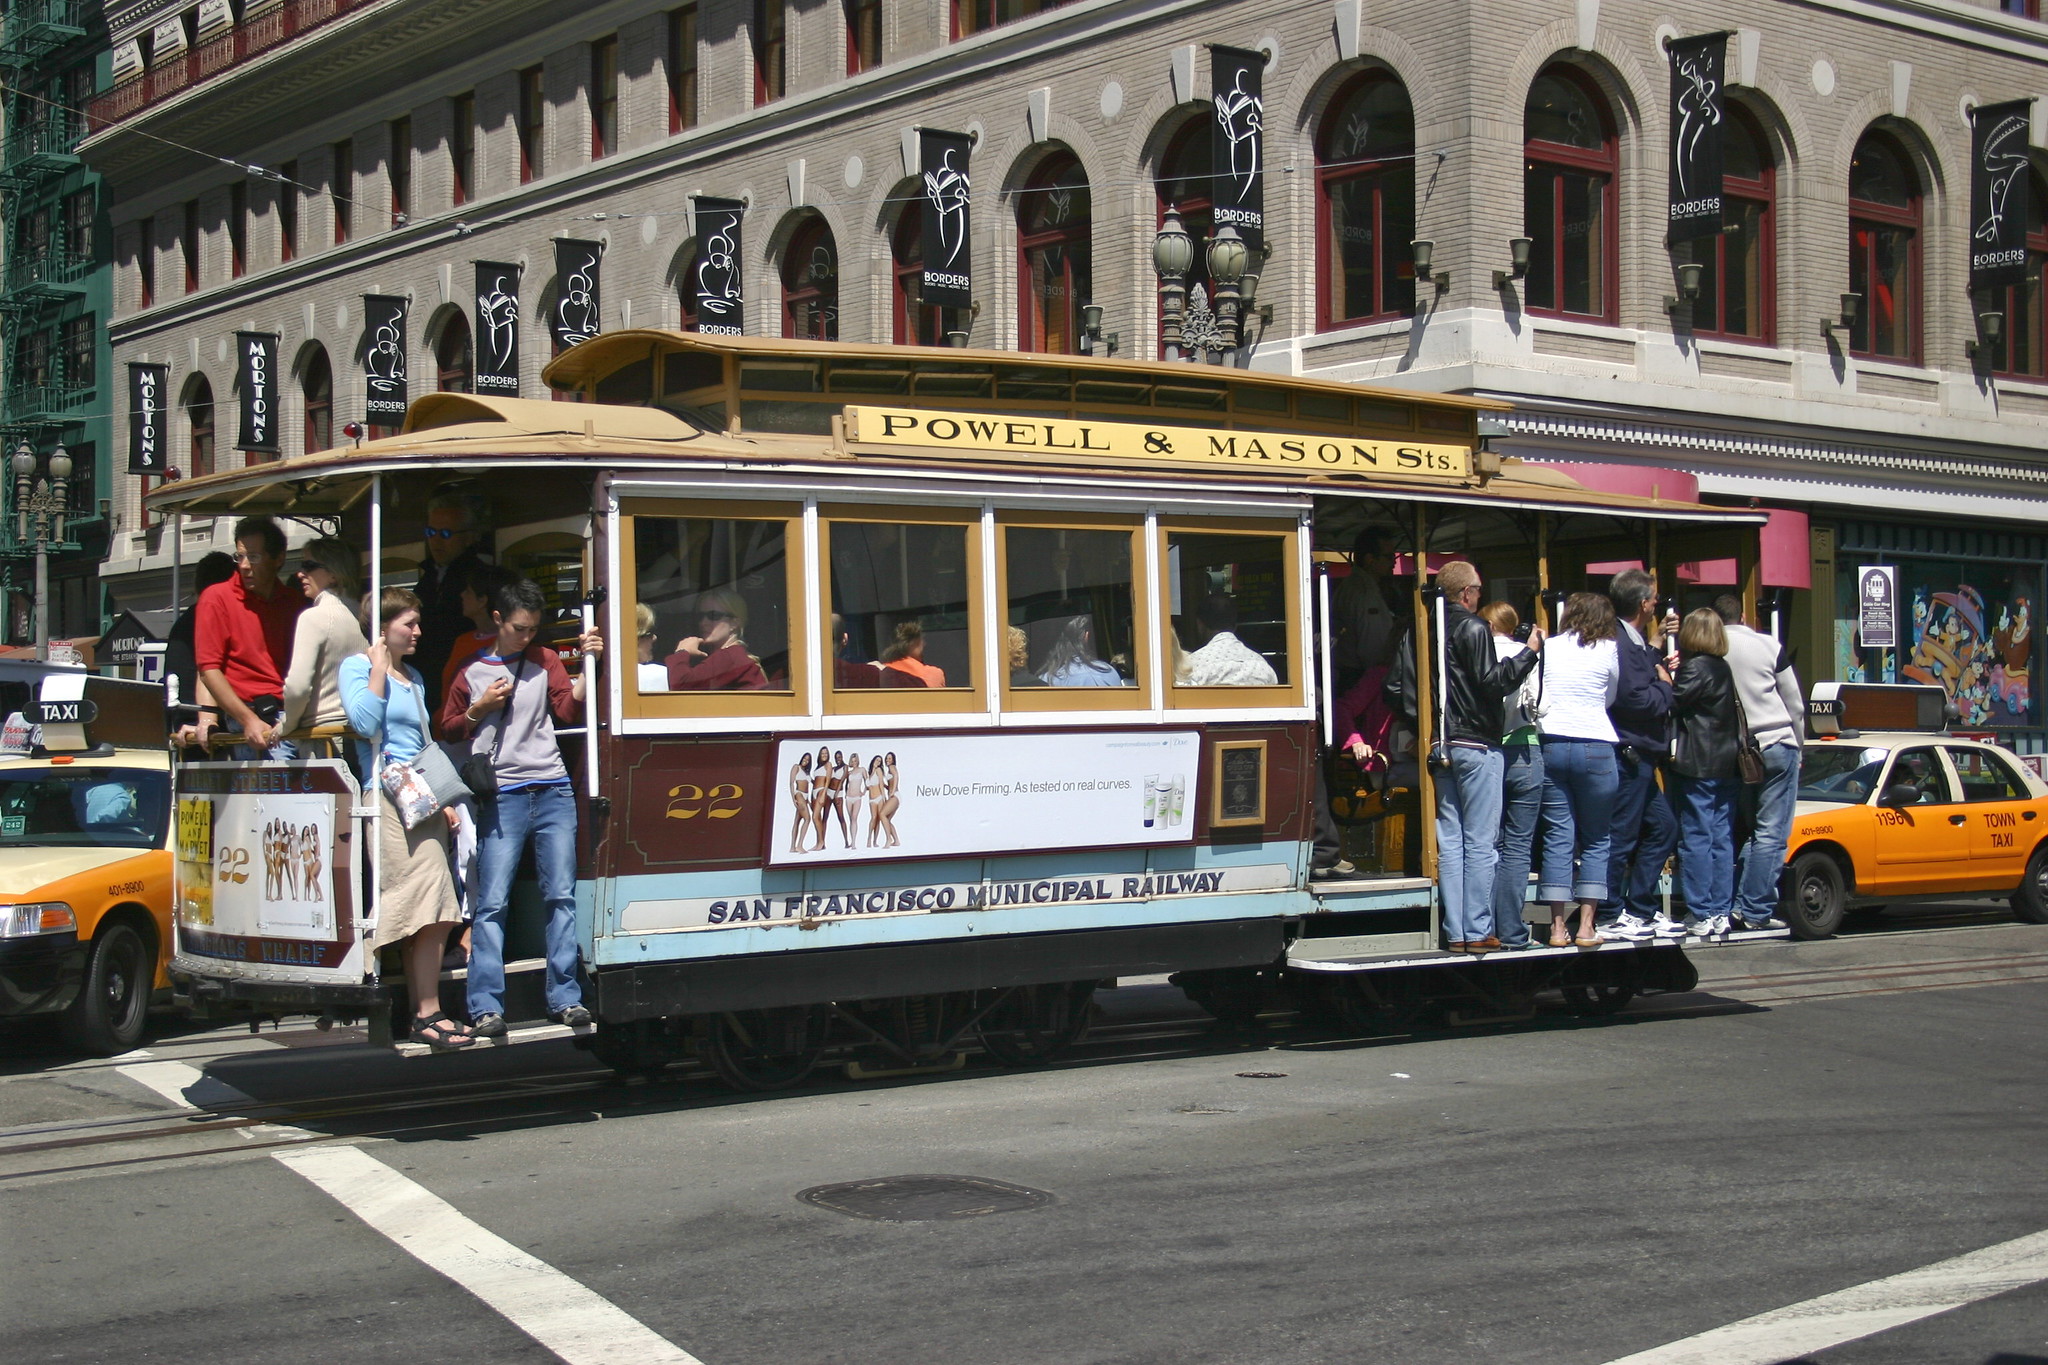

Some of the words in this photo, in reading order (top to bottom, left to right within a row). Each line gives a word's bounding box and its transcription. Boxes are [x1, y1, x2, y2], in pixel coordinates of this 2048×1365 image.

[1670, 197, 1721, 216] BORDERS
[1213, 207, 1262, 225] BORDERS
[1973, 249, 2025, 266] BORDERS
[923, 271, 970, 286] BORDERS
[699, 324, 742, 337] BORDERS
[477, 374, 518, 386] BORDERS
[249, 341, 266, 443] MORTONS
[367, 399, 406, 410] BORDERS
[140, 371, 156, 466] MORTONS
[880, 414, 1111, 451] POWELL
[1143, 431, 1176, 454] &
[1207, 435, 1379, 466] MASON
[1396, 446, 1458, 471] Sts.
[41, 704, 79, 720] TAXI
[1809, 702, 1833, 714] TAXI
[231, 772, 292, 792] STREET
[916, 785, 941, 797] New
[943, 783, 969, 796] Dove
[971, 782, 1012, 797] Firming.
[1014, 781, 1028, 793] As
[1029, 779, 1061, 793] tested
[1062, 782, 1075, 792] on
[1077, 778, 1096, 791] real
[1097, 779, 1133, 791] curves.
[665, 782, 744, 820] 22
[180, 811, 208, 826] POWELL
[1875, 811, 1905, 826] 1196
[1983, 812, 2016, 828] TOWN
[187, 827, 201, 839] AND
[1801, 825, 1834, 836] 401-8900
[1990, 832, 2014, 848] TAXI
[218, 845, 250, 884] 22
[108, 880, 145, 897] 401-8900
[707, 899, 772, 924] SAN
[784, 887, 956, 918] FRANCISCO
[967, 878, 1112, 907] MUNICIPAL
[1122, 871, 1226, 898] RAILWAY
